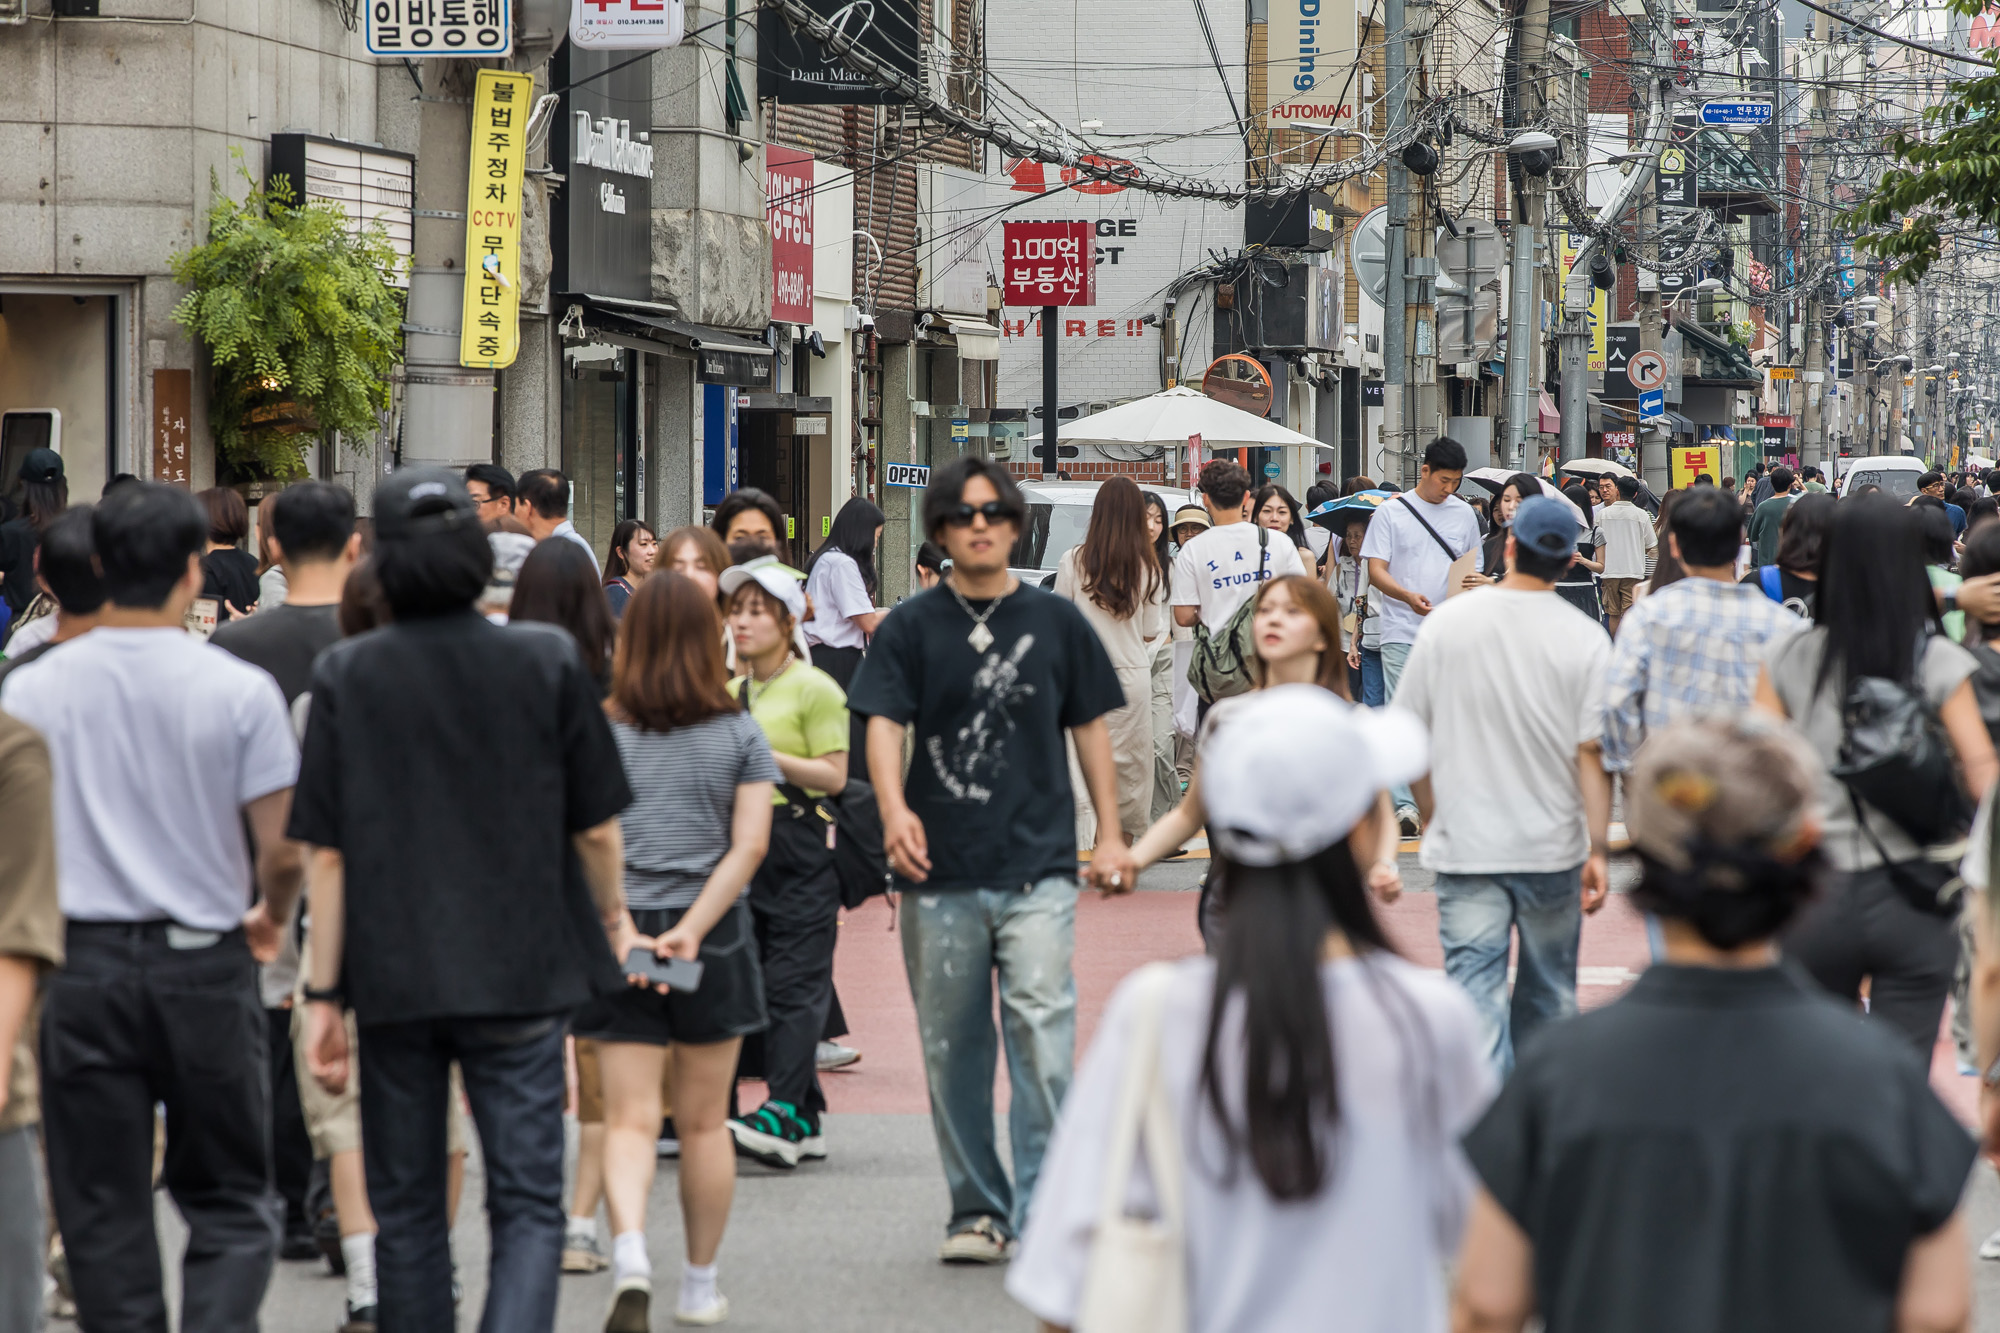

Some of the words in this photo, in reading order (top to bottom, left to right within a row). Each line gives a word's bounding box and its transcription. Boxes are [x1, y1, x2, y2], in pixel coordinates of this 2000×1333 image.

[375, 0, 500, 47] 일방통행
[1294, 0, 1320, 90] Dining
[790, 68, 824, 81] Dani
[1272, 104, 1352, 119] FUTOMAKI
[1736, 106, 1770, 115] 연무장길
[486, 81, 515, 204] 불법주정차
[473, 210, 516, 228] CCTV
[1012, 236, 1079, 263] 100억
[1010, 266, 1083, 294] 부동산
[1605, 433, 1635, 444] 옛날우동
[173, 417, 186, 482] 자연도
[889, 465, 928, 486] OPEN
[1213, 569, 1272, 589] STUDIO
